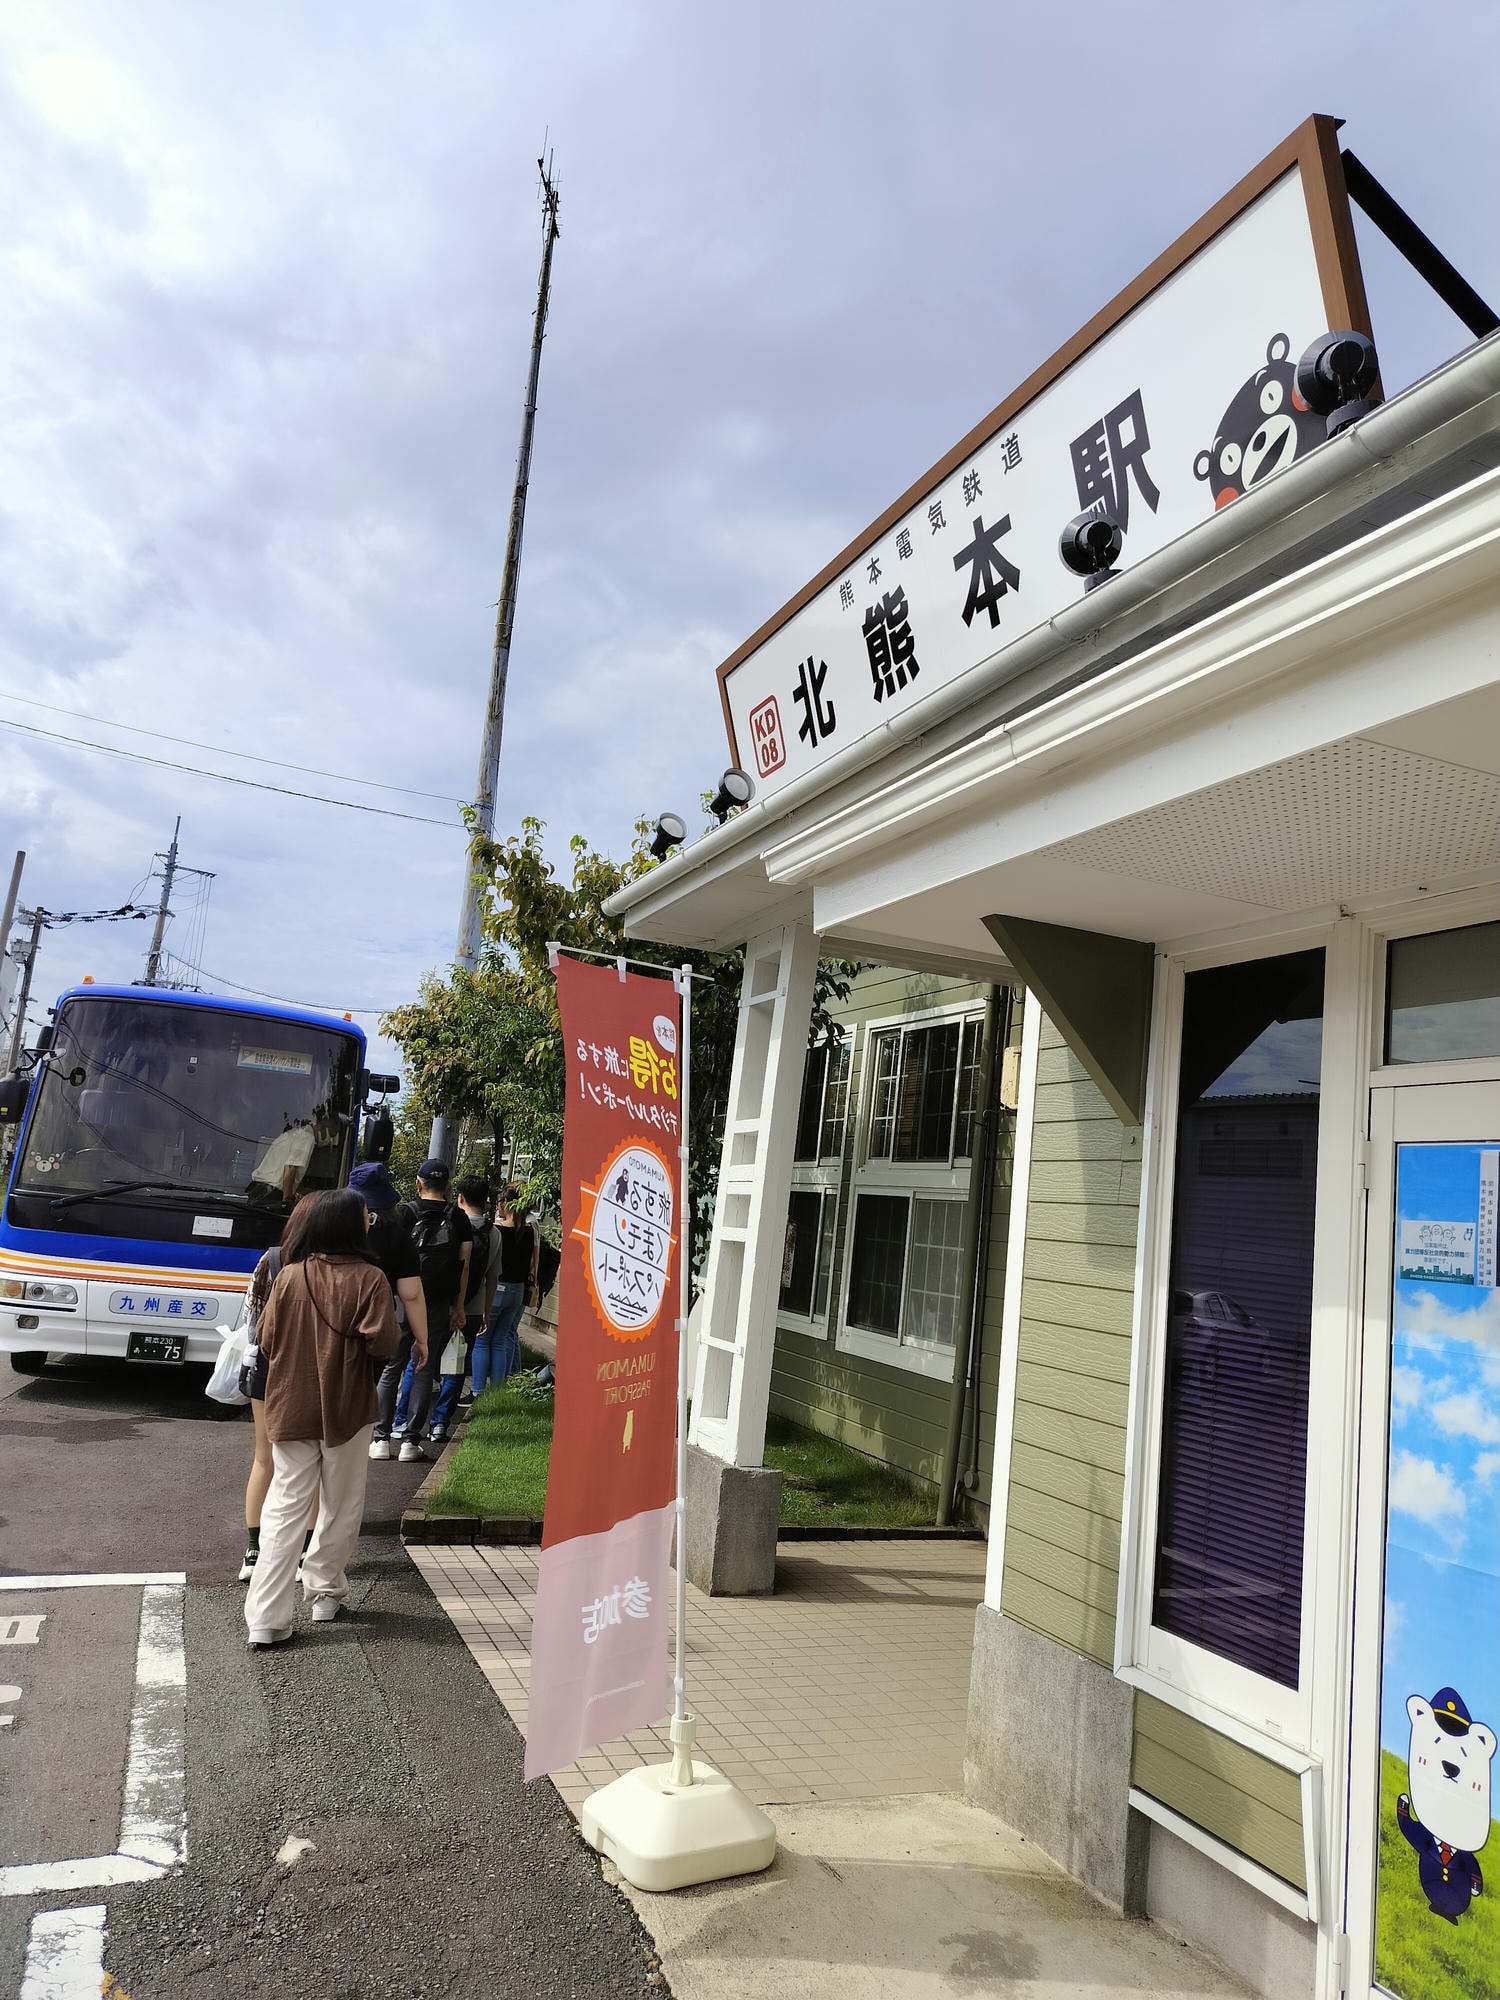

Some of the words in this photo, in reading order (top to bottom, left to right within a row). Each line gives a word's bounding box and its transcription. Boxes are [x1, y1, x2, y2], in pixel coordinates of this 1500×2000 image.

[838, 431, 1023, 611] 熊本電気鉄道
[792, 388, 1160, 748] 北熊本駅
[754, 706, 777, 736] KD
[760, 737, 779, 768] 08
[120, 1296, 207, 1315] 九州産交
